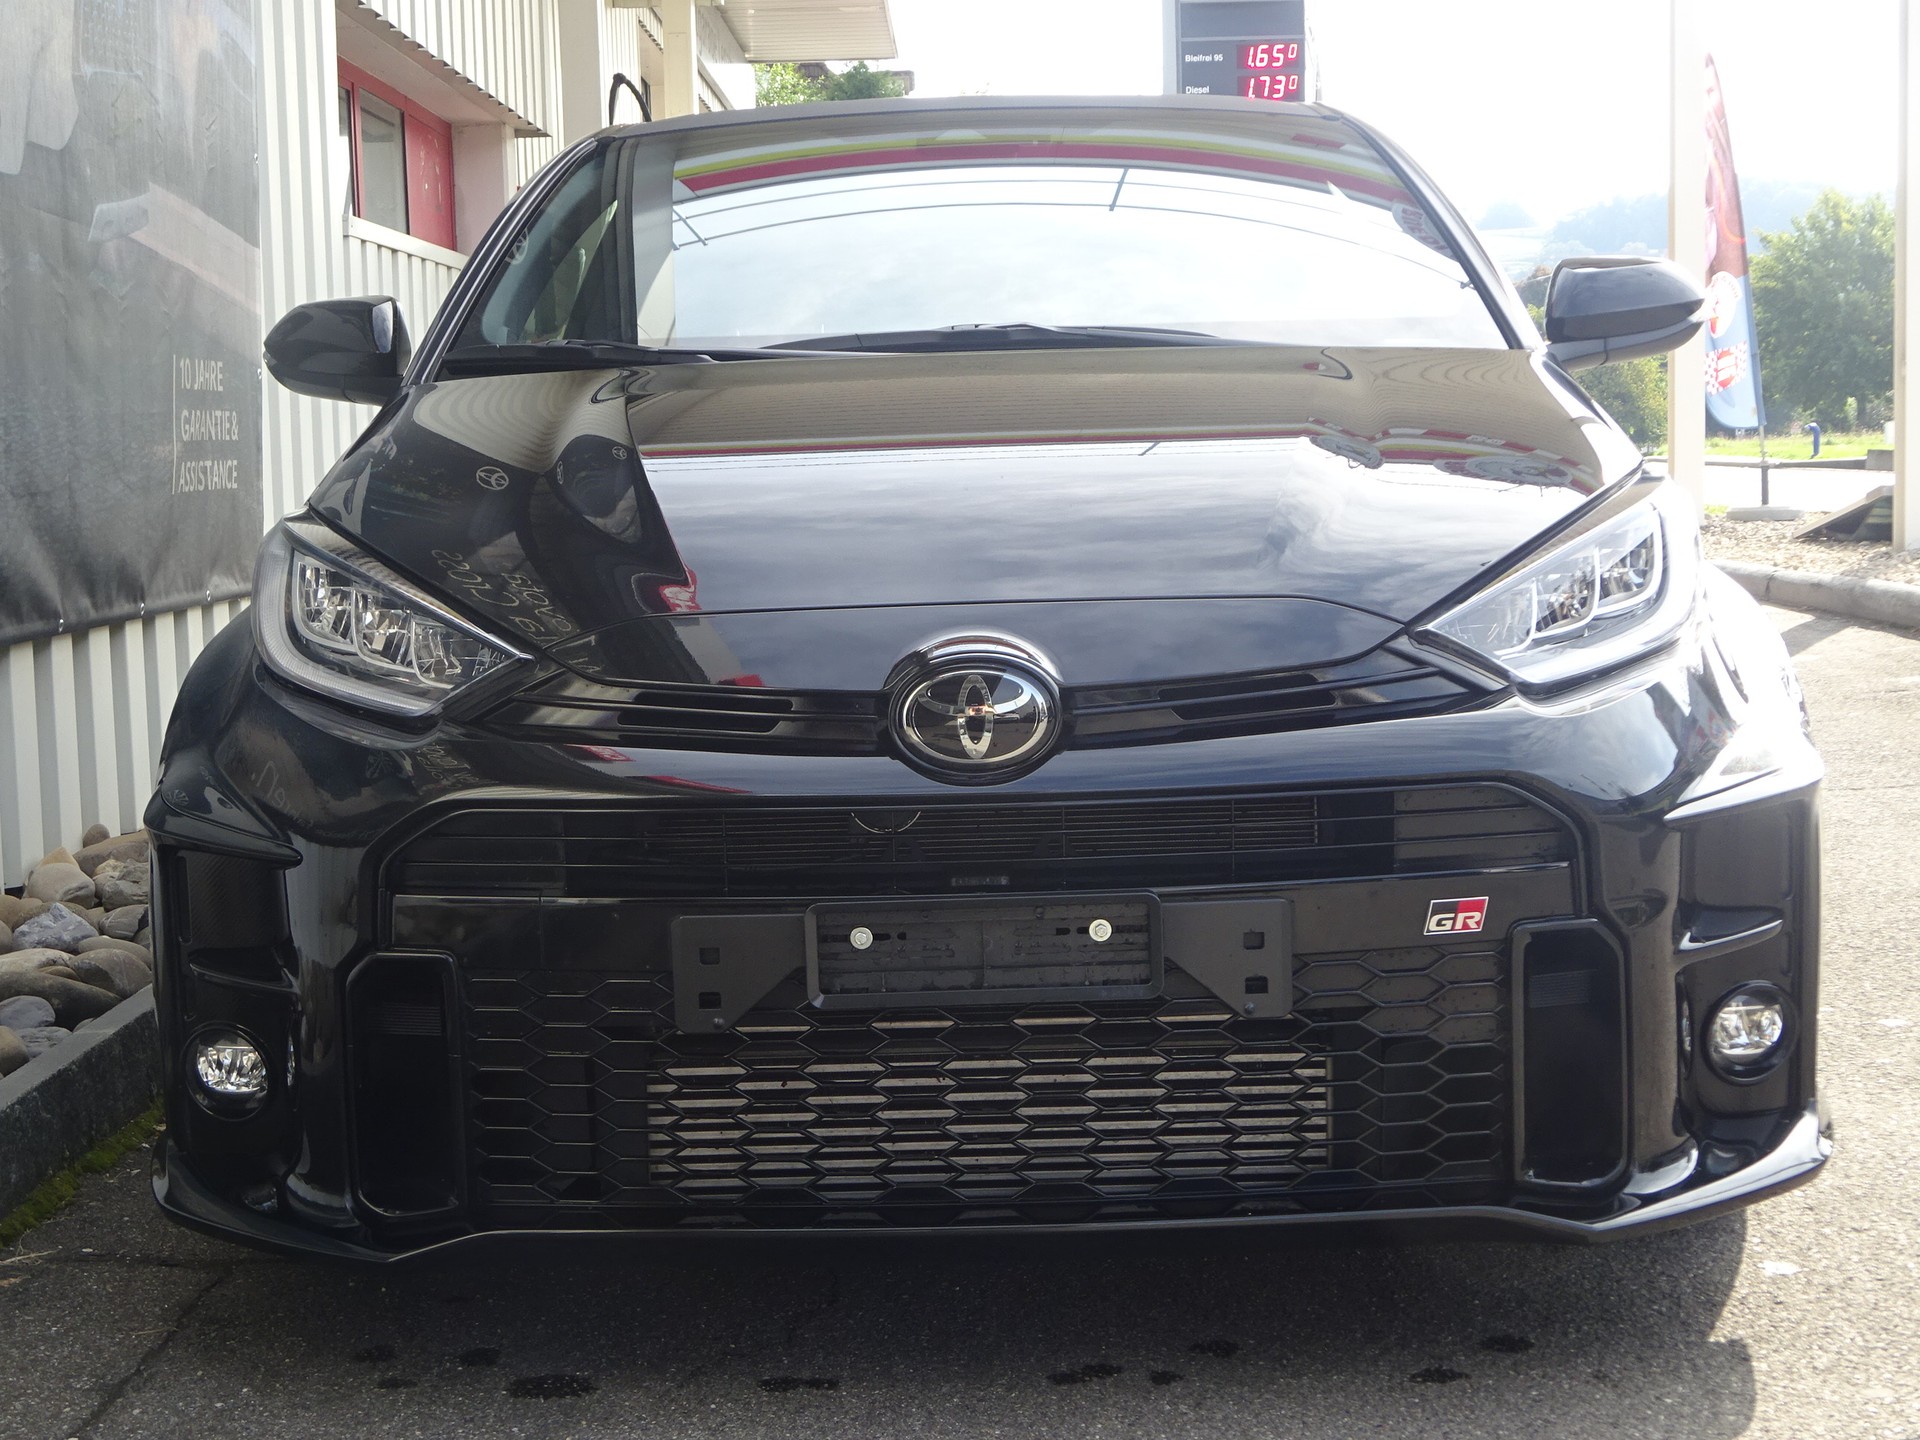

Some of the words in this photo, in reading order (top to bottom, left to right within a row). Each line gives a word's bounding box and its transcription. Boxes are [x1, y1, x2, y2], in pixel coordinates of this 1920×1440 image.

[1185, 54, 1213, 62] Bleifrei
[1214, 54, 1224, 62] 95
[1186, 86, 1209, 94] Diesel
[180, 357, 192, 390] 10
[194, 359, 224, 392] JAHRE
[178, 459, 238, 494] ASSISTANCE
[1428, 911, 1482, 932] GR
